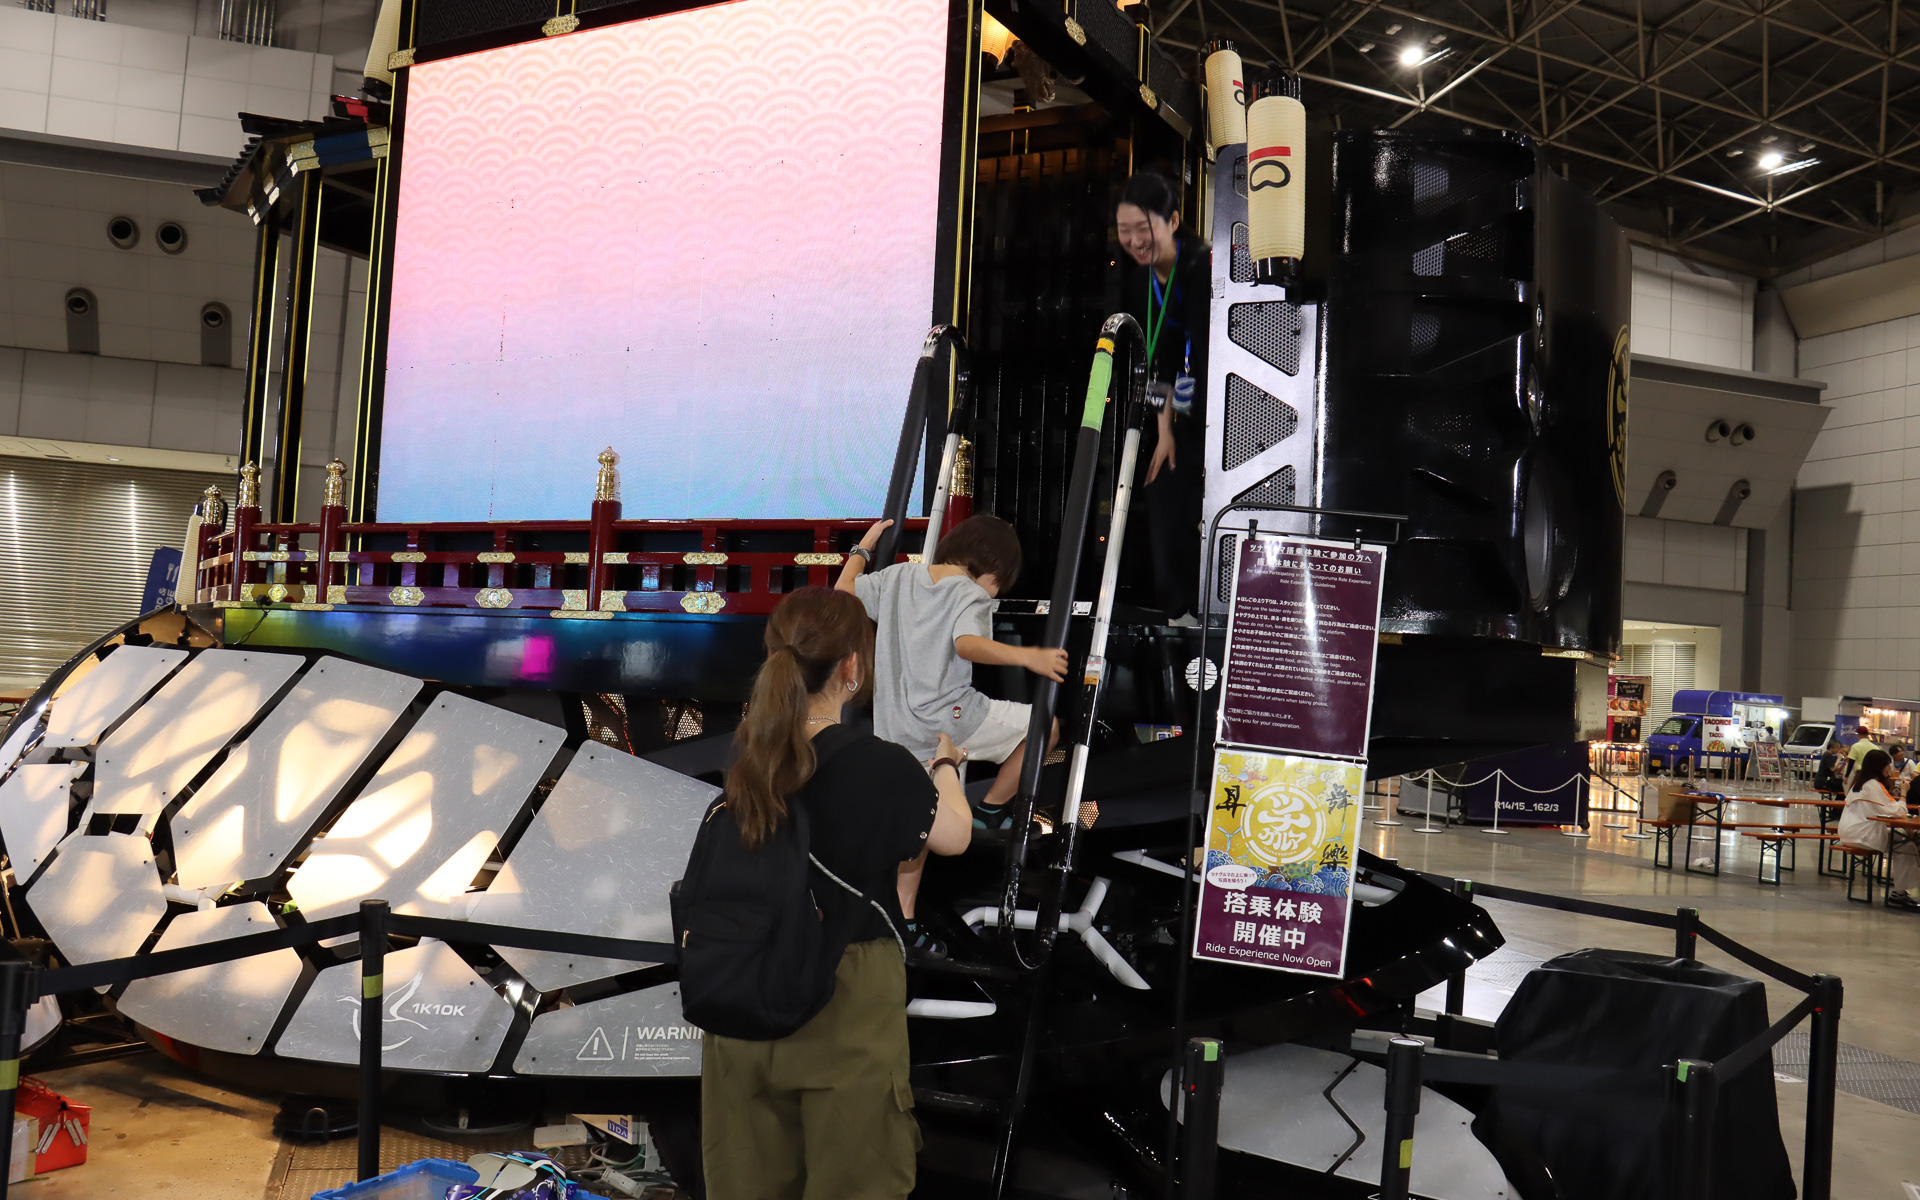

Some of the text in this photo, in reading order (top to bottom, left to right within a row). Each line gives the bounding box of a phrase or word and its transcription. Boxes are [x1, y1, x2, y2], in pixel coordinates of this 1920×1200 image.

[1272, 722, 1302, 730] cooperation.
[1704, 718, 1731, 726] TACORICE
[1223, 891, 1323, 925] 搭乗体験
[1233, 920, 1306, 950] 開催中
[1205, 942, 1332, 968] Ride Experience Now Open
[412, 1003, 466, 1016] 1K10K
